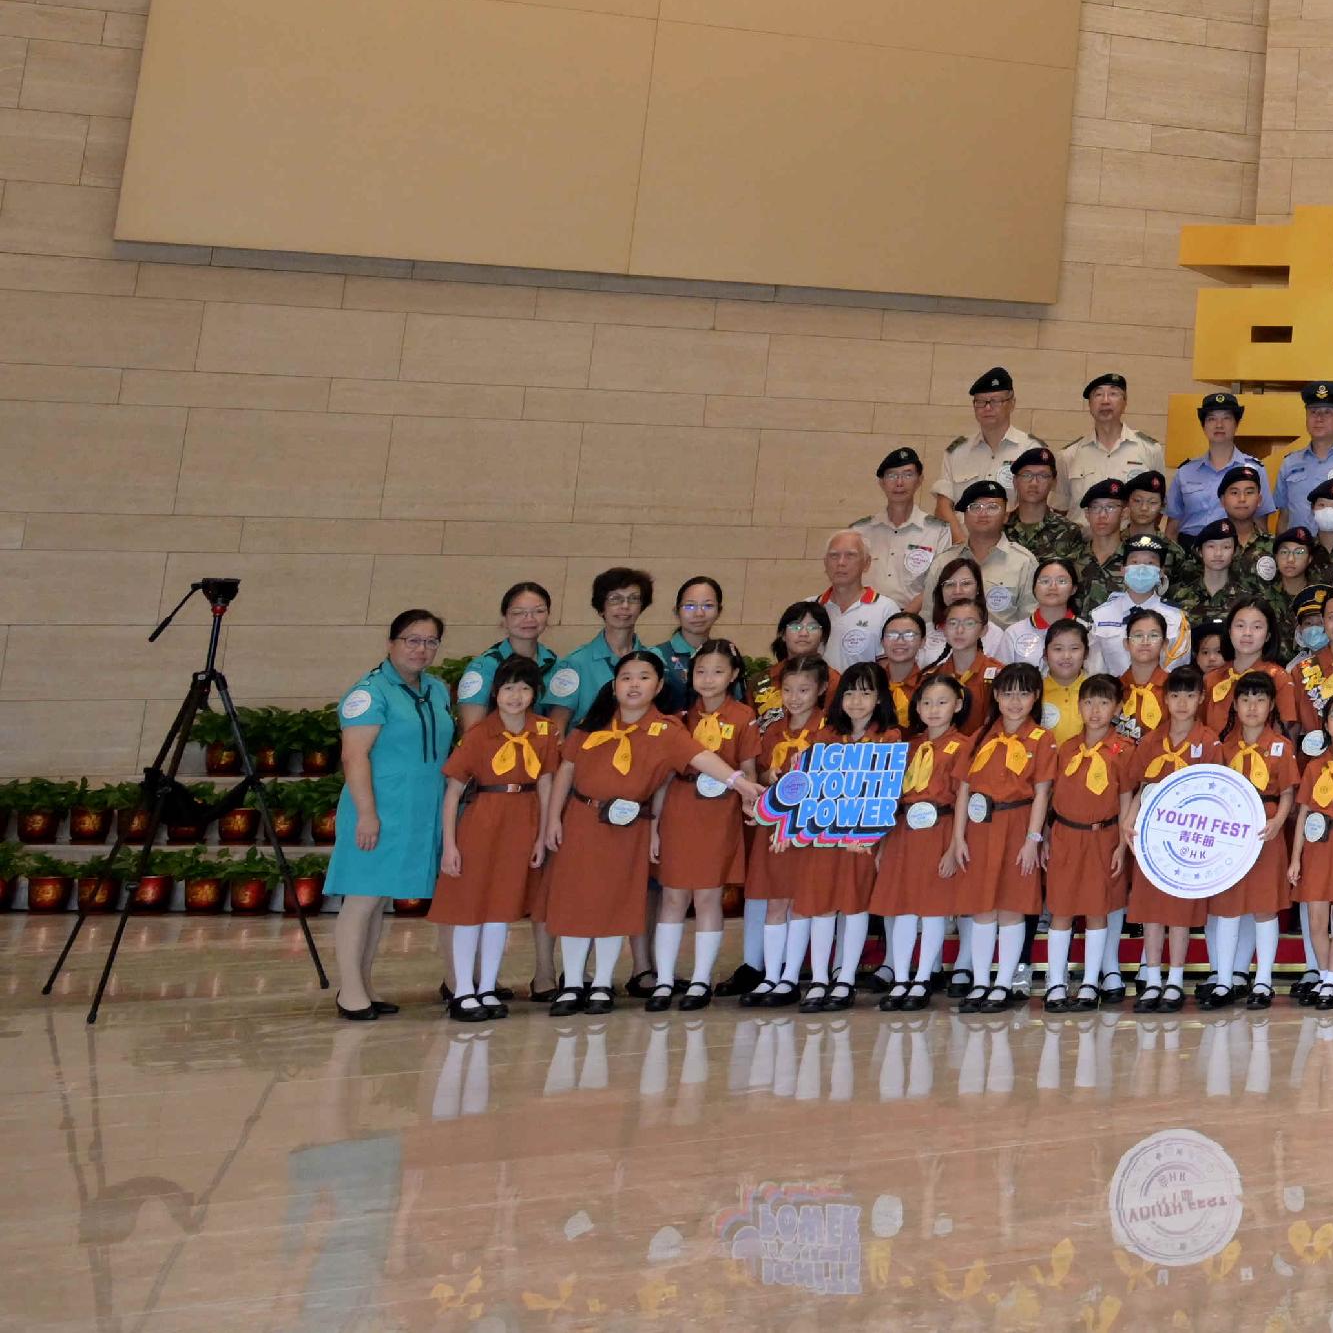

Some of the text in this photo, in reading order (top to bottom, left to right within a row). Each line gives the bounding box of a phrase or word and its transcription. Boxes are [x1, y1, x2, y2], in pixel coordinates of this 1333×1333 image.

[809, 742, 909, 771] IGNITE
[808, 770, 904, 799] YOUTH
[797, 798, 898, 827] POWER
[1156, 808, 1251, 838] YOUTH FEST
[1179, 830, 1215, 847] 青年節
